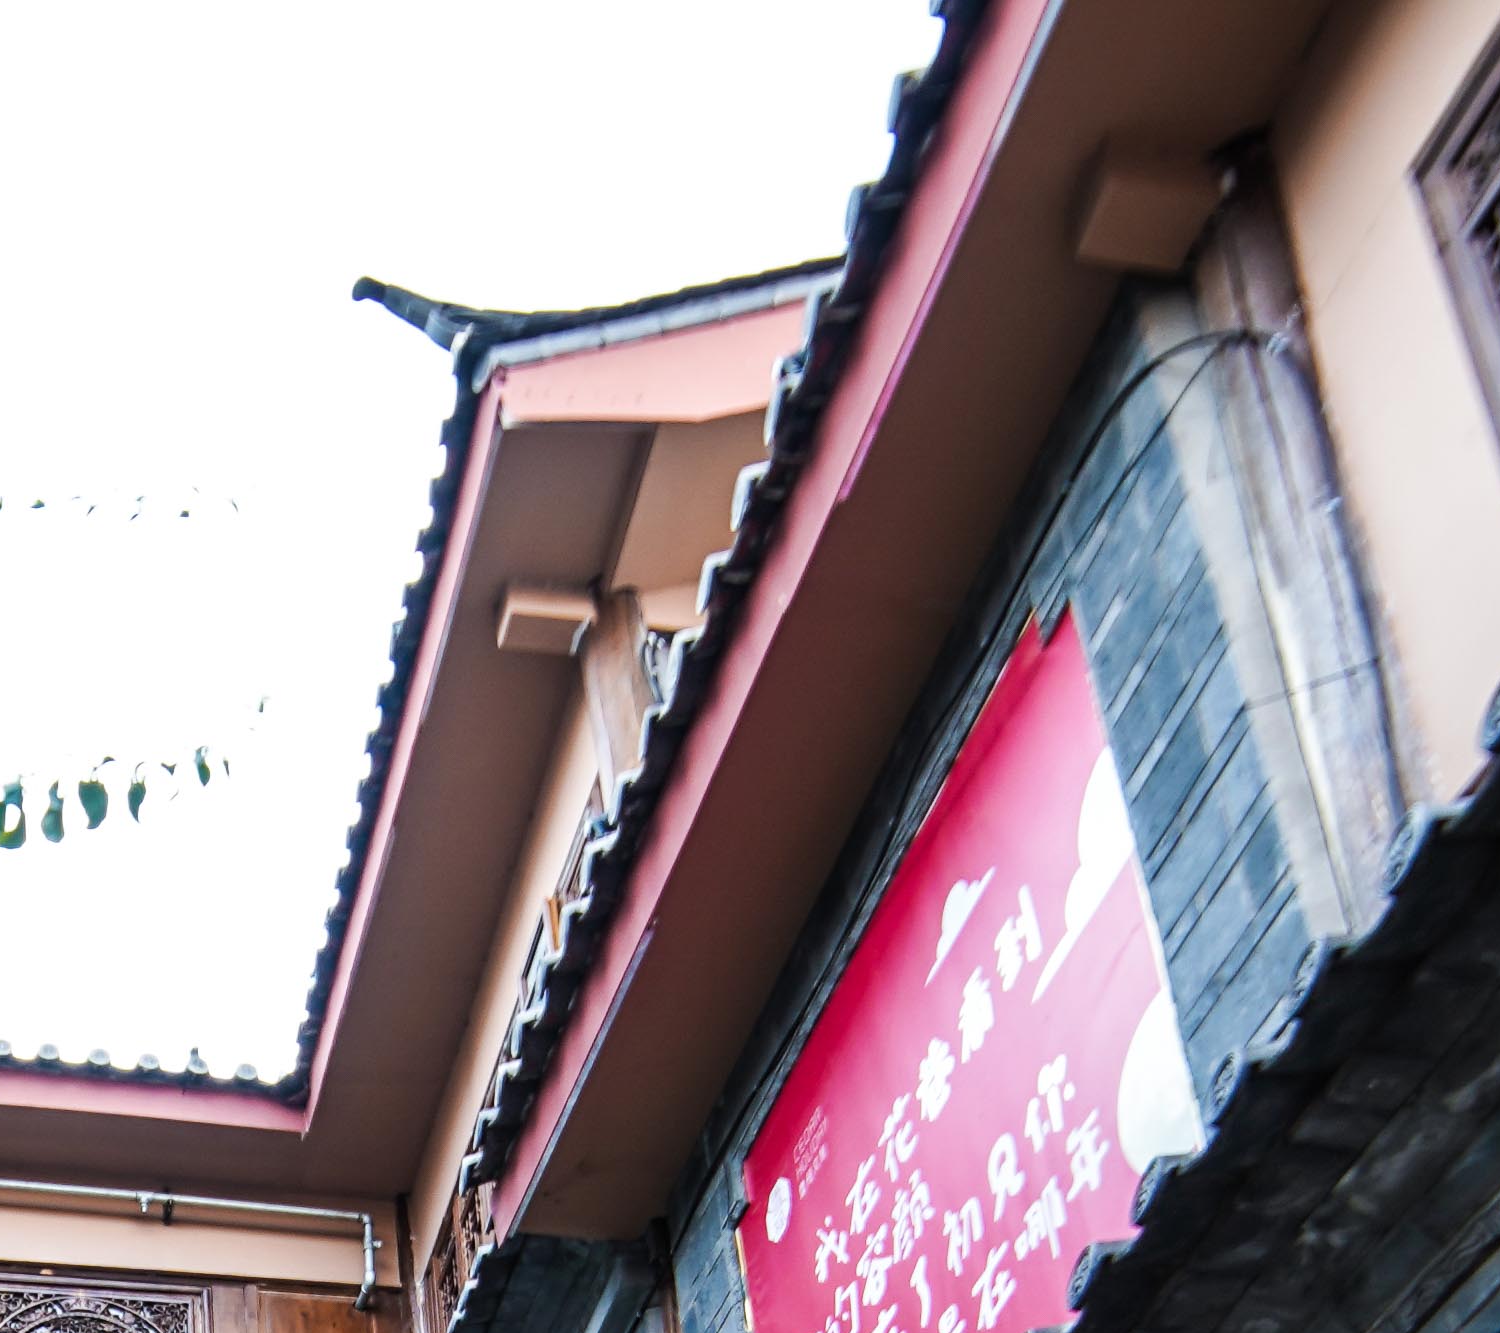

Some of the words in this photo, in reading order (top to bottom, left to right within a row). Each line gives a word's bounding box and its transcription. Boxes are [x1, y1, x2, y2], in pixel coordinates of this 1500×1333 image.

[815, 884, 1042, 1282] 我在花巷看到
